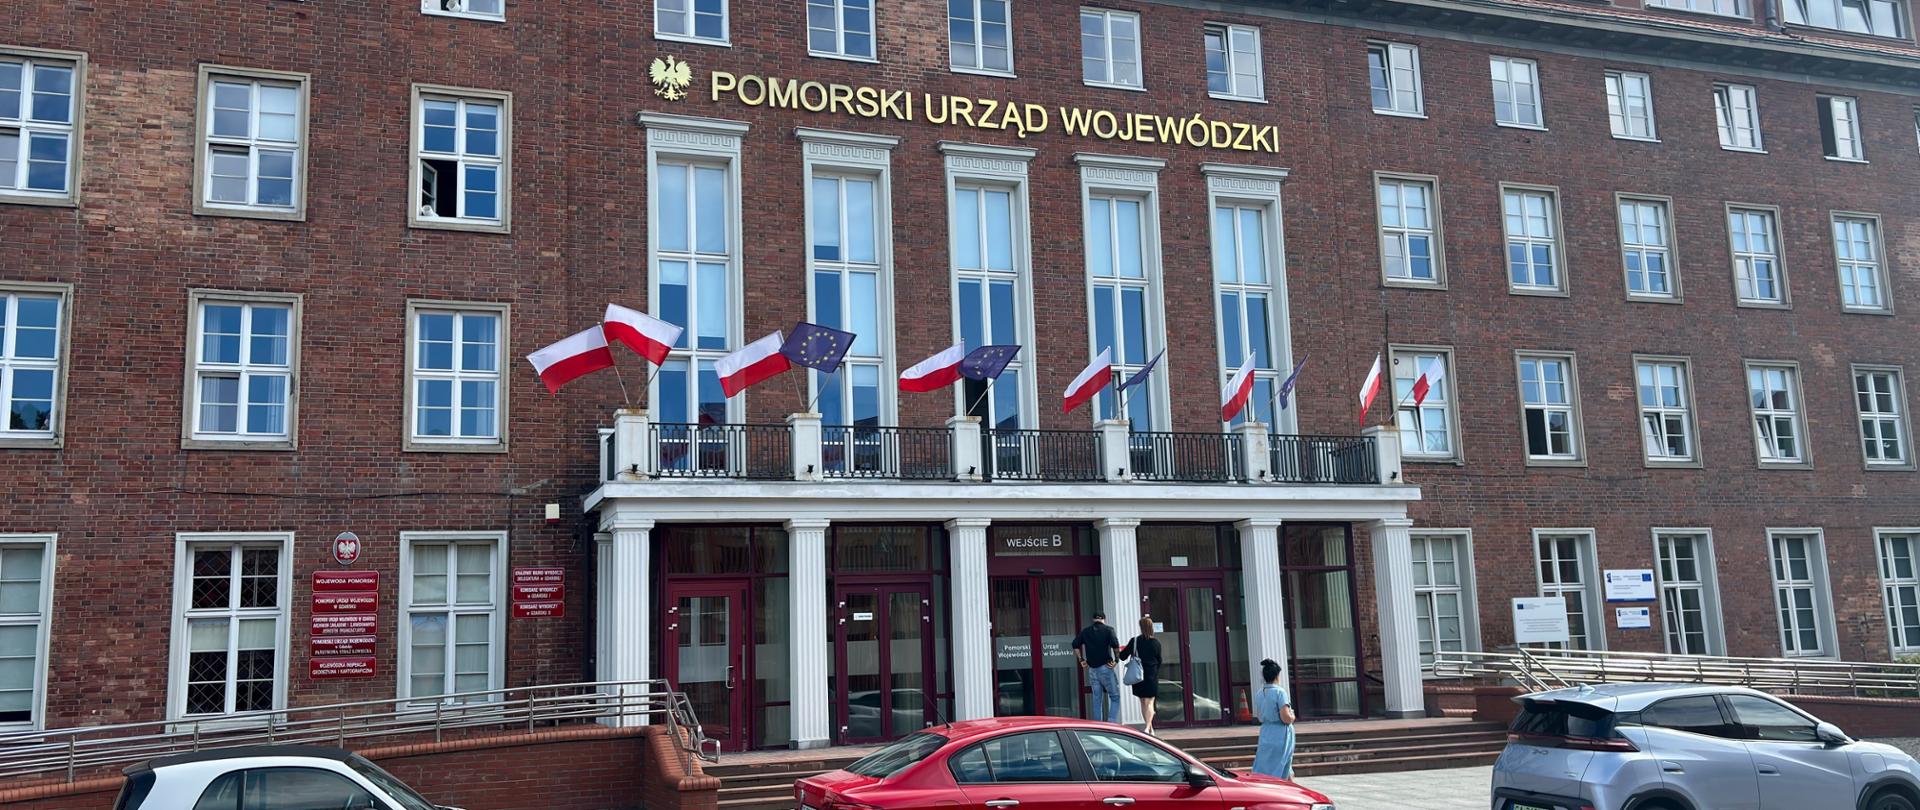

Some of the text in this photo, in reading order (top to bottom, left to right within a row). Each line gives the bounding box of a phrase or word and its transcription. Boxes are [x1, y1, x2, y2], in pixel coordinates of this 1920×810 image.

[711, 71, 1280, 153] POMORSKI URZĄD WOJEWÓDZKI
[1006, 534, 1062, 547] WEJŚCIE B
